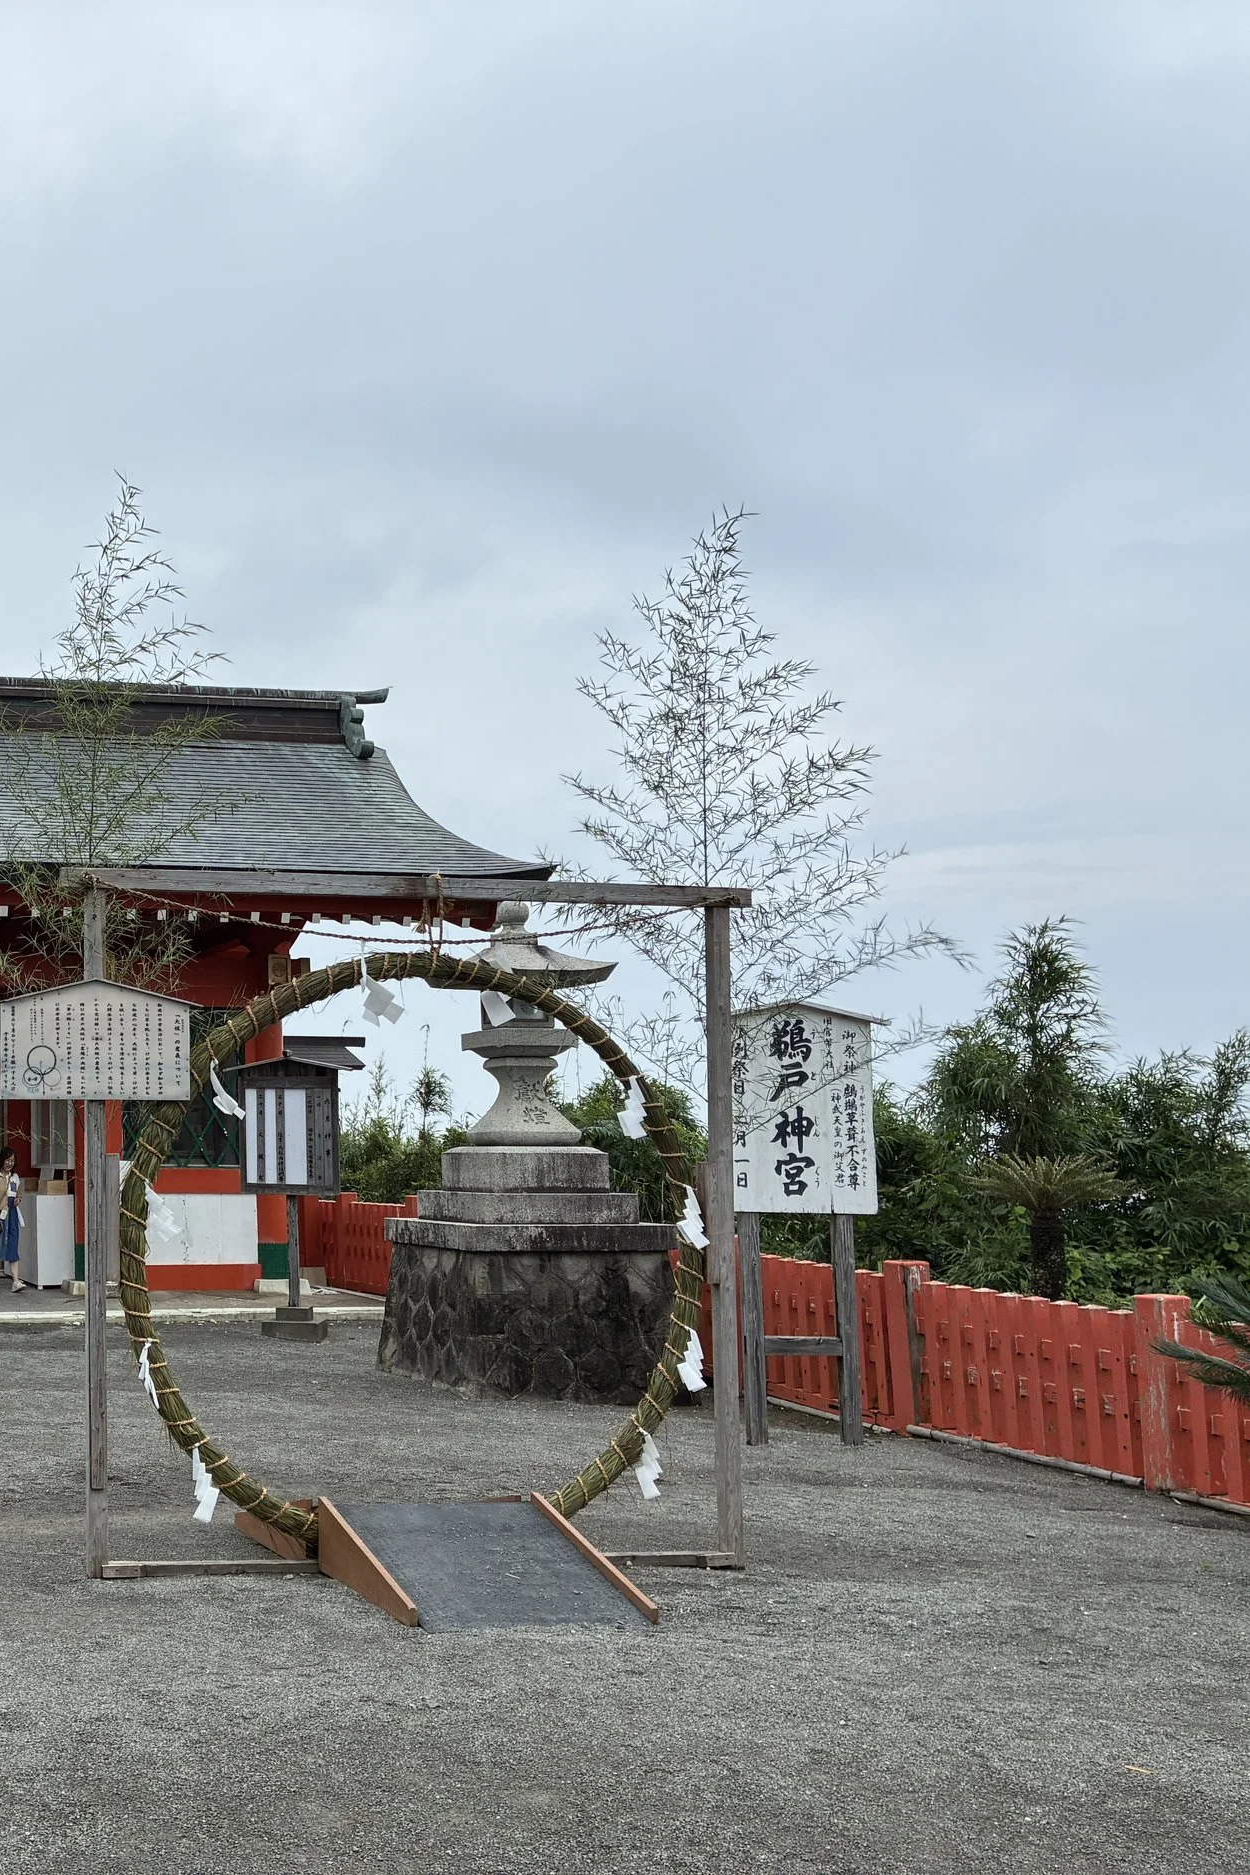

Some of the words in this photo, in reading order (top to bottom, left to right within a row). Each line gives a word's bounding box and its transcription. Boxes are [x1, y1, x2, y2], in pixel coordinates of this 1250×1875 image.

[174, 1014, 182, 1086] 「大祓」の意義について
[810, 1029, 816, 1040] う
[842, 1030, 858, 1074] 御祭神
[810, 1071, 816, 1081] と
[768, 1018, 816, 1198] 鵜戸神宮
